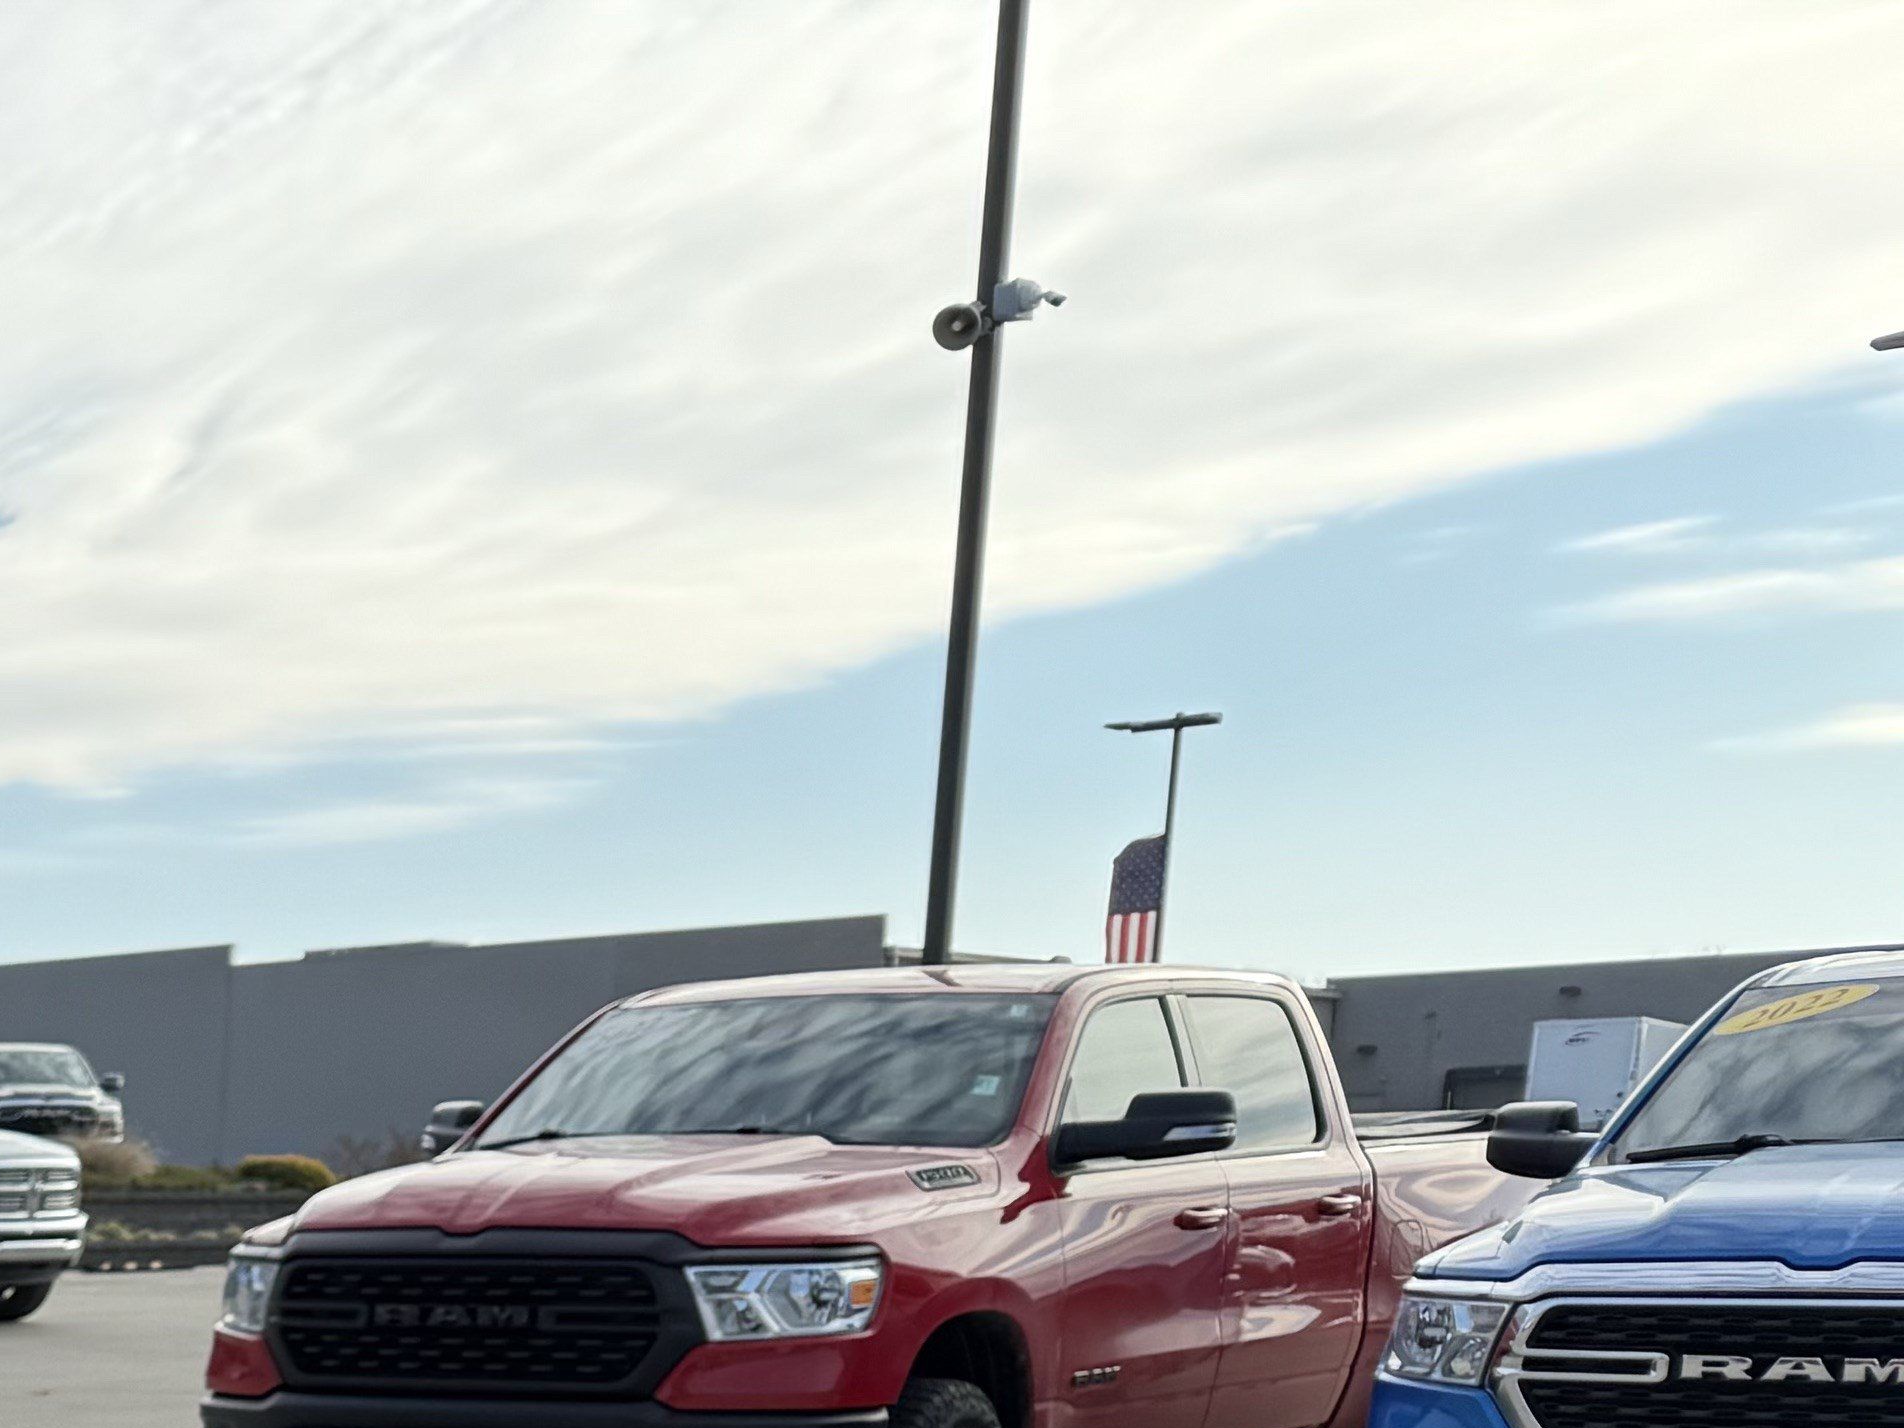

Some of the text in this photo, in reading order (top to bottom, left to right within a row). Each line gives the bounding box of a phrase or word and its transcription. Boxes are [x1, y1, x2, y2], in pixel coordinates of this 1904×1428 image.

[1741, 987, 1852, 1030] 2022
[374, 1303, 529, 1328] RAM
[1679, 1354, 1904, 1382] RAM
